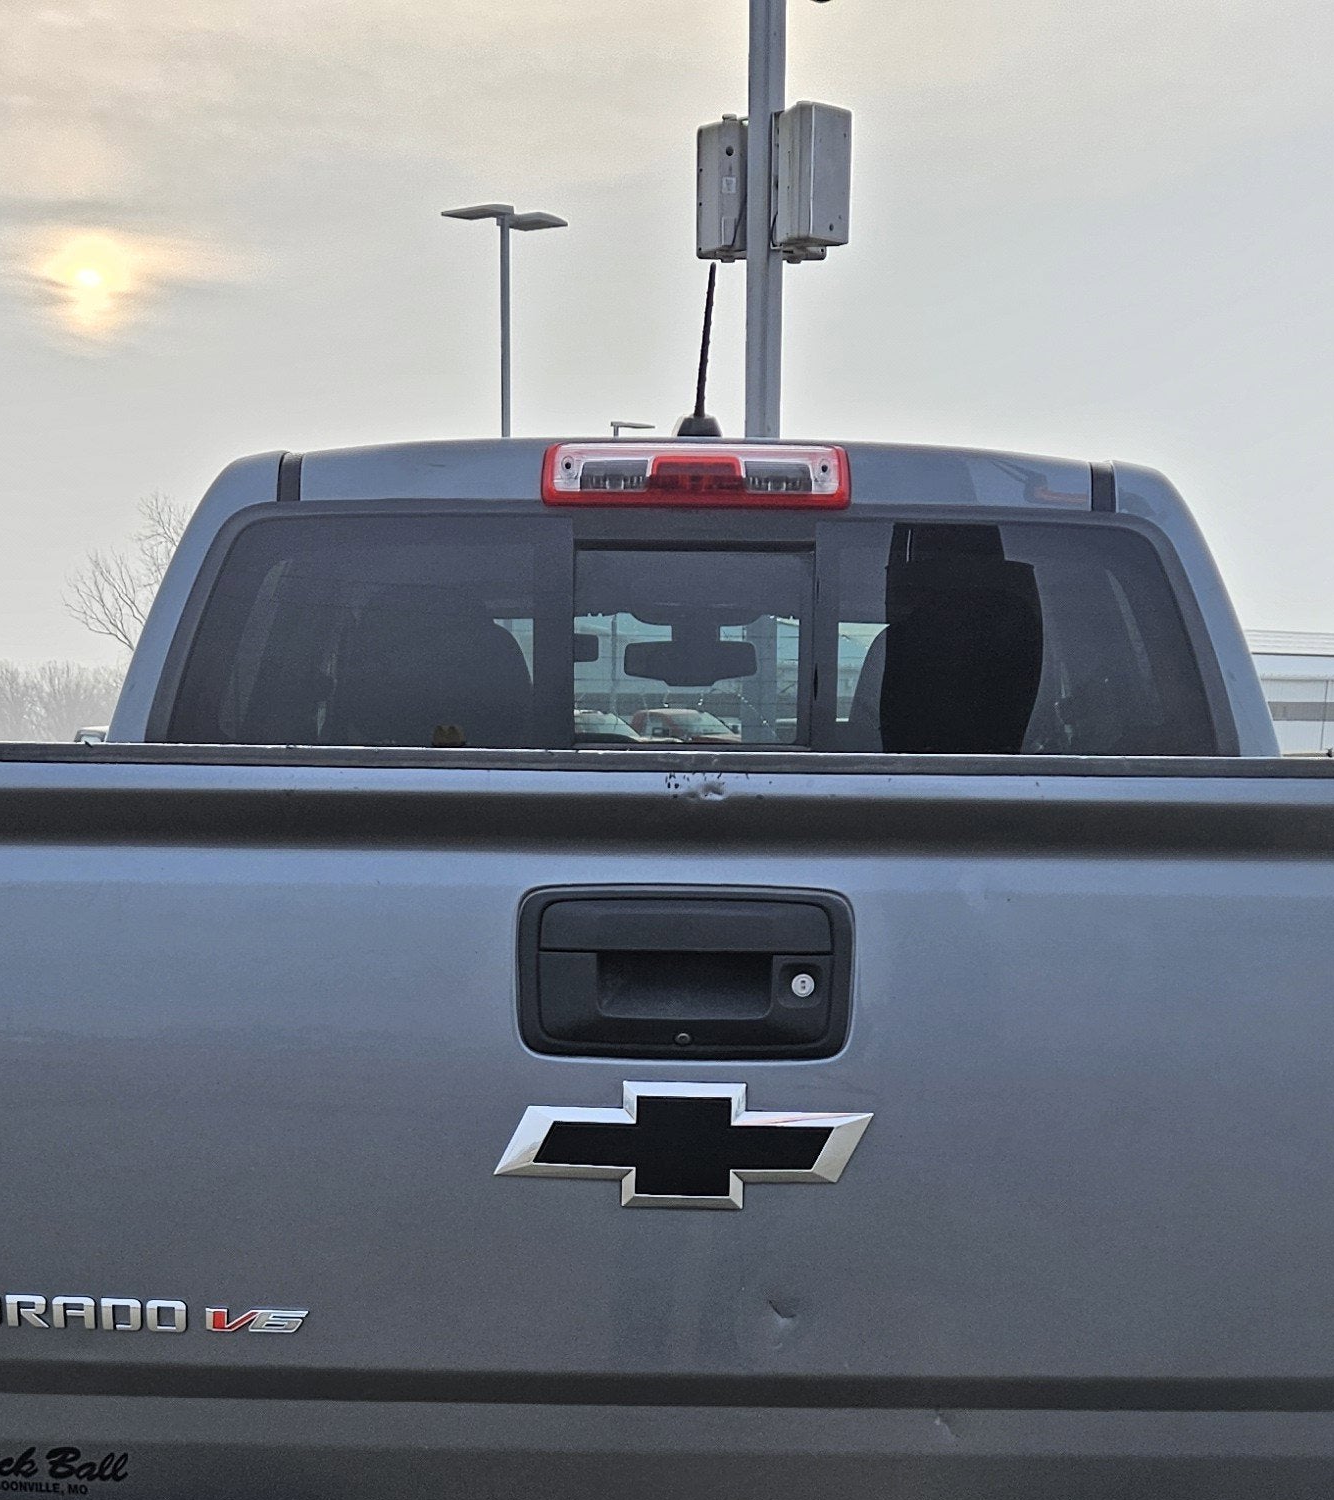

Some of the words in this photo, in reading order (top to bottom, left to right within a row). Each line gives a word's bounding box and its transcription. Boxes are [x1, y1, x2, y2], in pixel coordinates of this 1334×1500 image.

[205, 1306, 310, 1333] V6
[45, 1446, 129, 1482] Ball
[68, 1483, 88, 1495] MO
